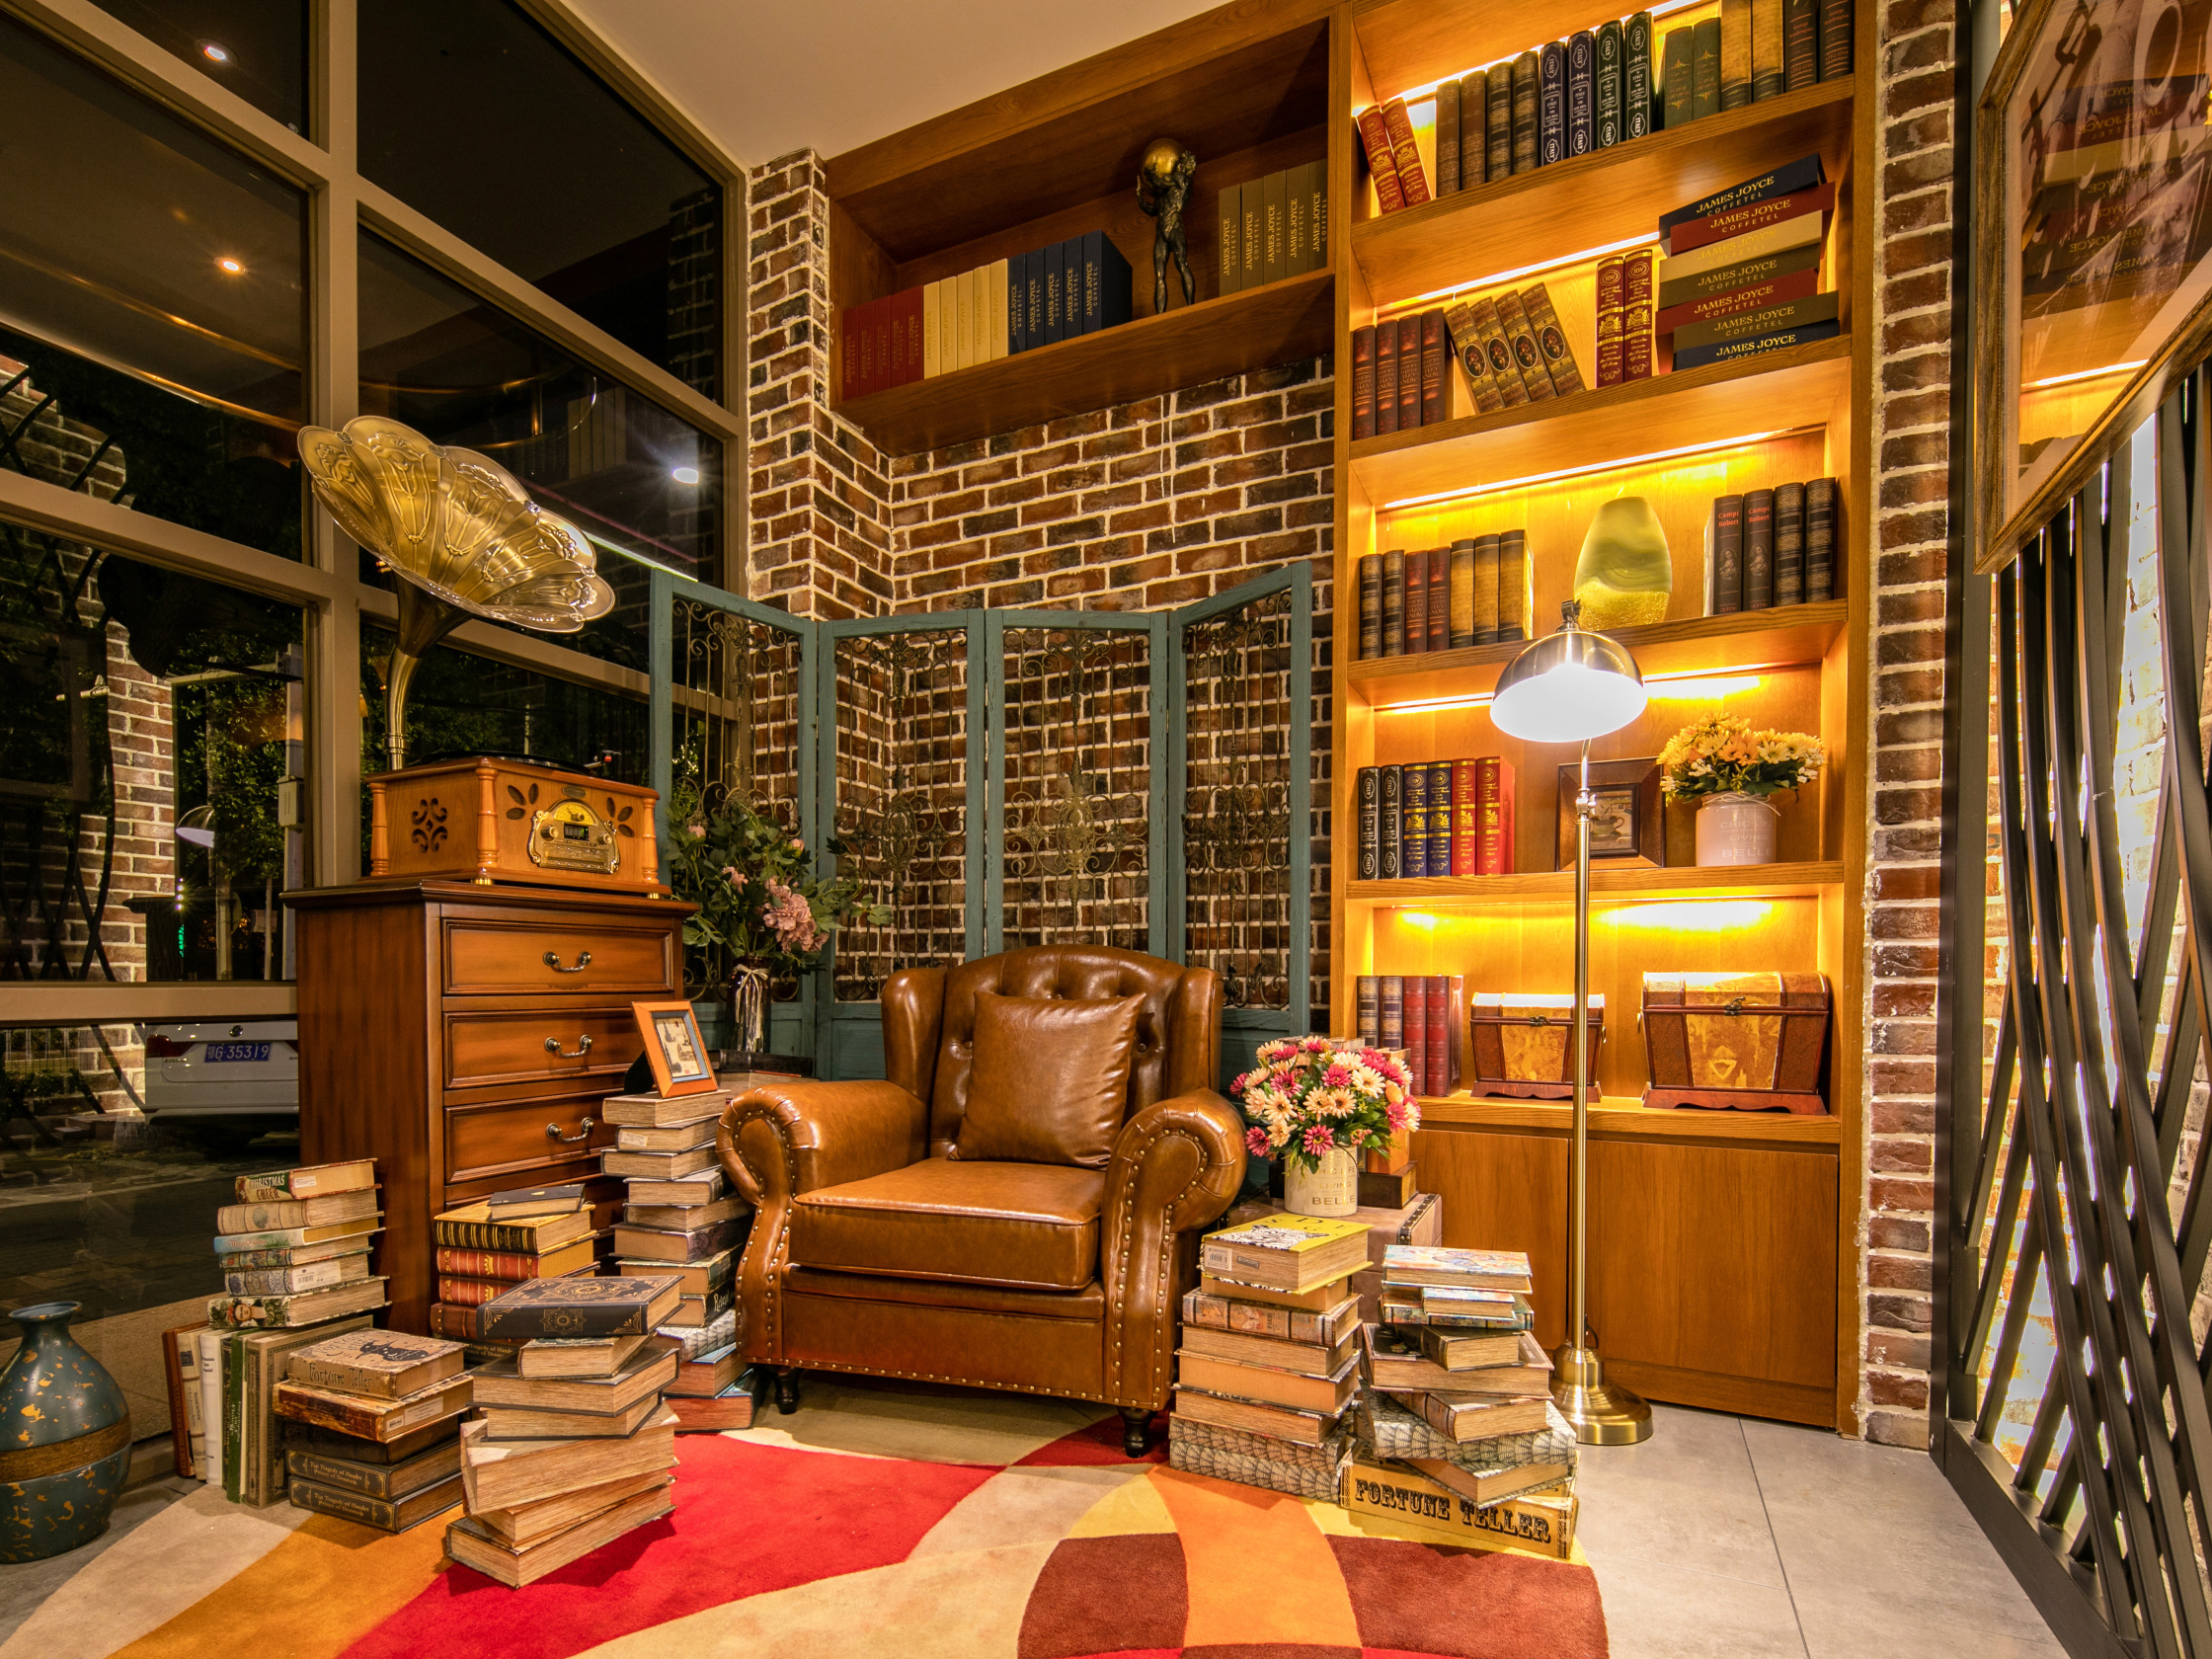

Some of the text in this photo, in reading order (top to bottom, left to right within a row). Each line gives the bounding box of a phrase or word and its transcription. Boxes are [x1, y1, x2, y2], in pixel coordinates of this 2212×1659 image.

[1697, 176, 1775, 213] JAMES JOYCE
[1707, 192, 1763, 216] COFFETEL
[1710, 199, 1790, 228] JAMES JOYCE
[1722, 213, 1778, 233] COFFETEL
[1698, 260, 1778, 286] JAMES JOYCE
[1709, 274, 1766, 291] COFFETEL
[1695, 285, 1774, 314] JAMES JOYCE
[1705, 299, 1762, 318] COFFETEL
[1714, 306, 1795, 331] JAMES JOYCE
[1726, 320, 1782, 337] COFFETEL
[1716, 334, 1796, 356] JAMES JOYCE
[1718, 511, 1739, 519] Campi
[1748, 506, 1770, 514] Campi
[1749, 514, 1770, 523] Robert
[249, 1175, 284, 1189] CHRISTMAS
[257, 1188, 279, 1200] CHEER
[713, 1290, 730, 1311] Reveal
[309, 1363, 372, 1387] Fortune Teller
[320, 1464, 338, 1473] Tragedy
[346, 1471, 361, 1480] Hamlet
[325, 1495, 343, 1505] Tragedy
[352, 1502, 368, 1511] Hamlet
[1355, 1477, 1551, 1543] FORTUNE TELLER
